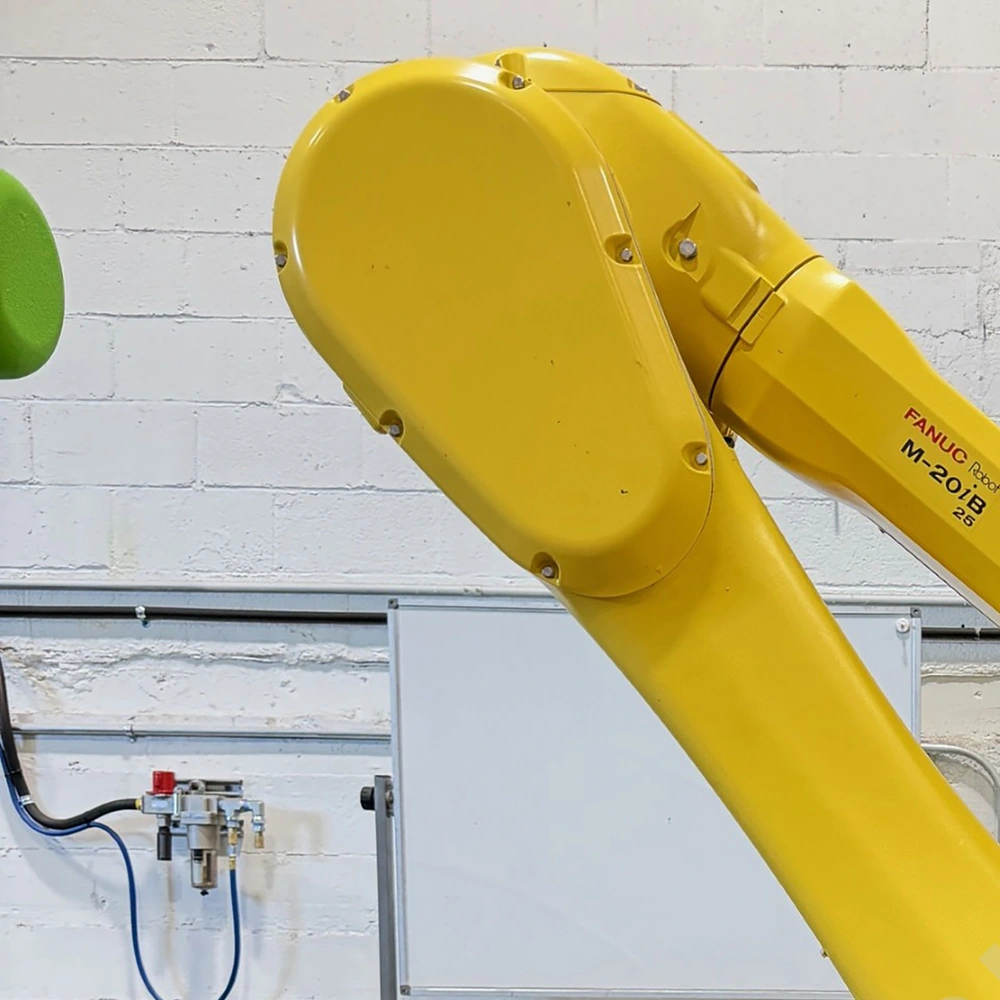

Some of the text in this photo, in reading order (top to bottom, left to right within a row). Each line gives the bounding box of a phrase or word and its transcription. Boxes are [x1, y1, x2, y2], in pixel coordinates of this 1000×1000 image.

[900, 439, 987, 515] M-20iB
[903, 407, 1000, 493] FANUC Robot
[952, 507, 976, 527] 25
